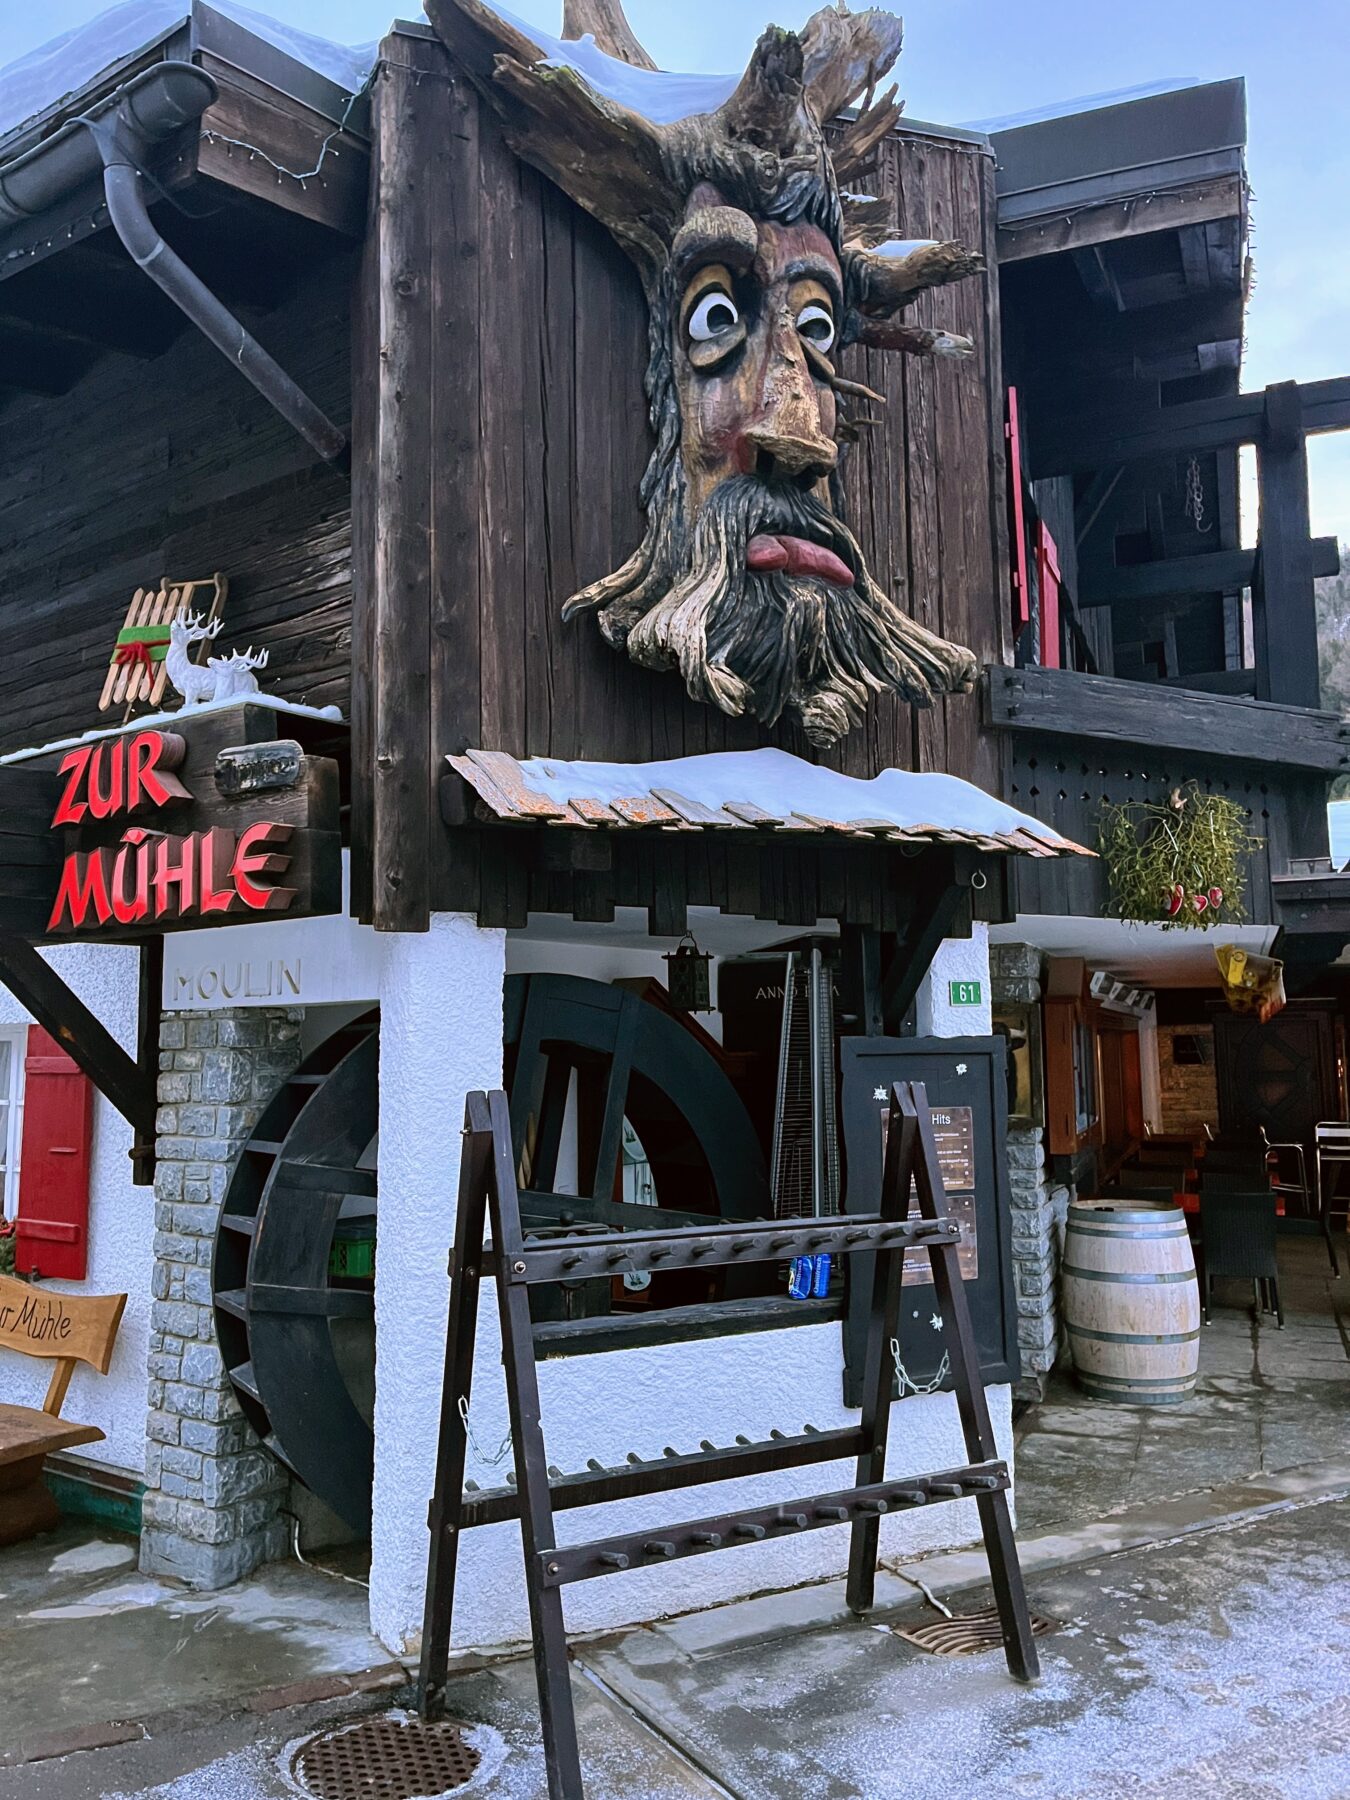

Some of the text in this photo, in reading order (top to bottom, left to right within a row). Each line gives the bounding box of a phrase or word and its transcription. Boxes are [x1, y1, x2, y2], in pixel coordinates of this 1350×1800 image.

[50, 730, 186, 829] ZUR
[46, 821, 289, 933] MÜHLE
[173, 959, 301, 1001] MOULIN
[959, 984, 974, 1002] 61
[931, 1113, 951, 1125] Hits
[10, 1296, 72, 1340] Mühle
